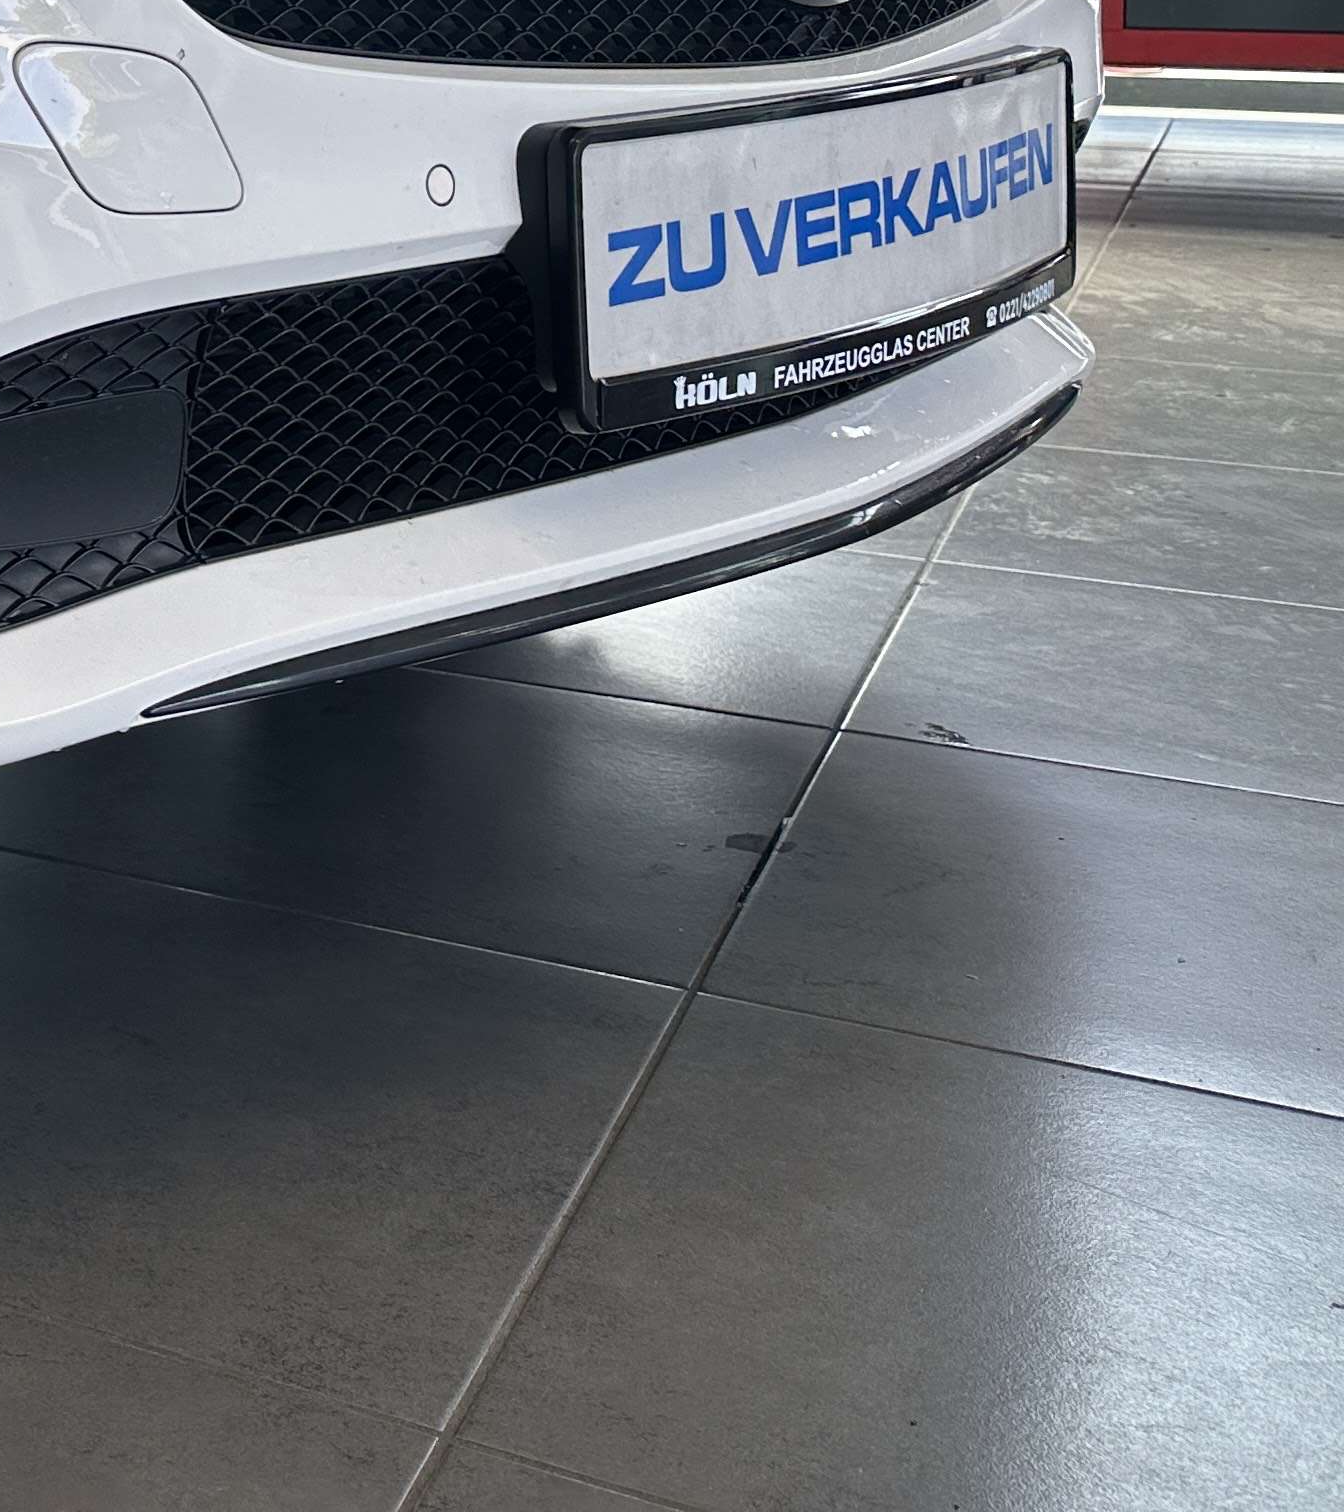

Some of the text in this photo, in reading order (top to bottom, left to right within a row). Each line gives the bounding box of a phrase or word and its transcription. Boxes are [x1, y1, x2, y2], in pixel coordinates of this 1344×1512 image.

[607, 122, 1055, 307] ZU VERKAUFEN
[674, 371, 757, 410] KÖLN
[773, 334, 913, 389] FAHRZEUGGLAS
[917, 316, 971, 351] CENTER
